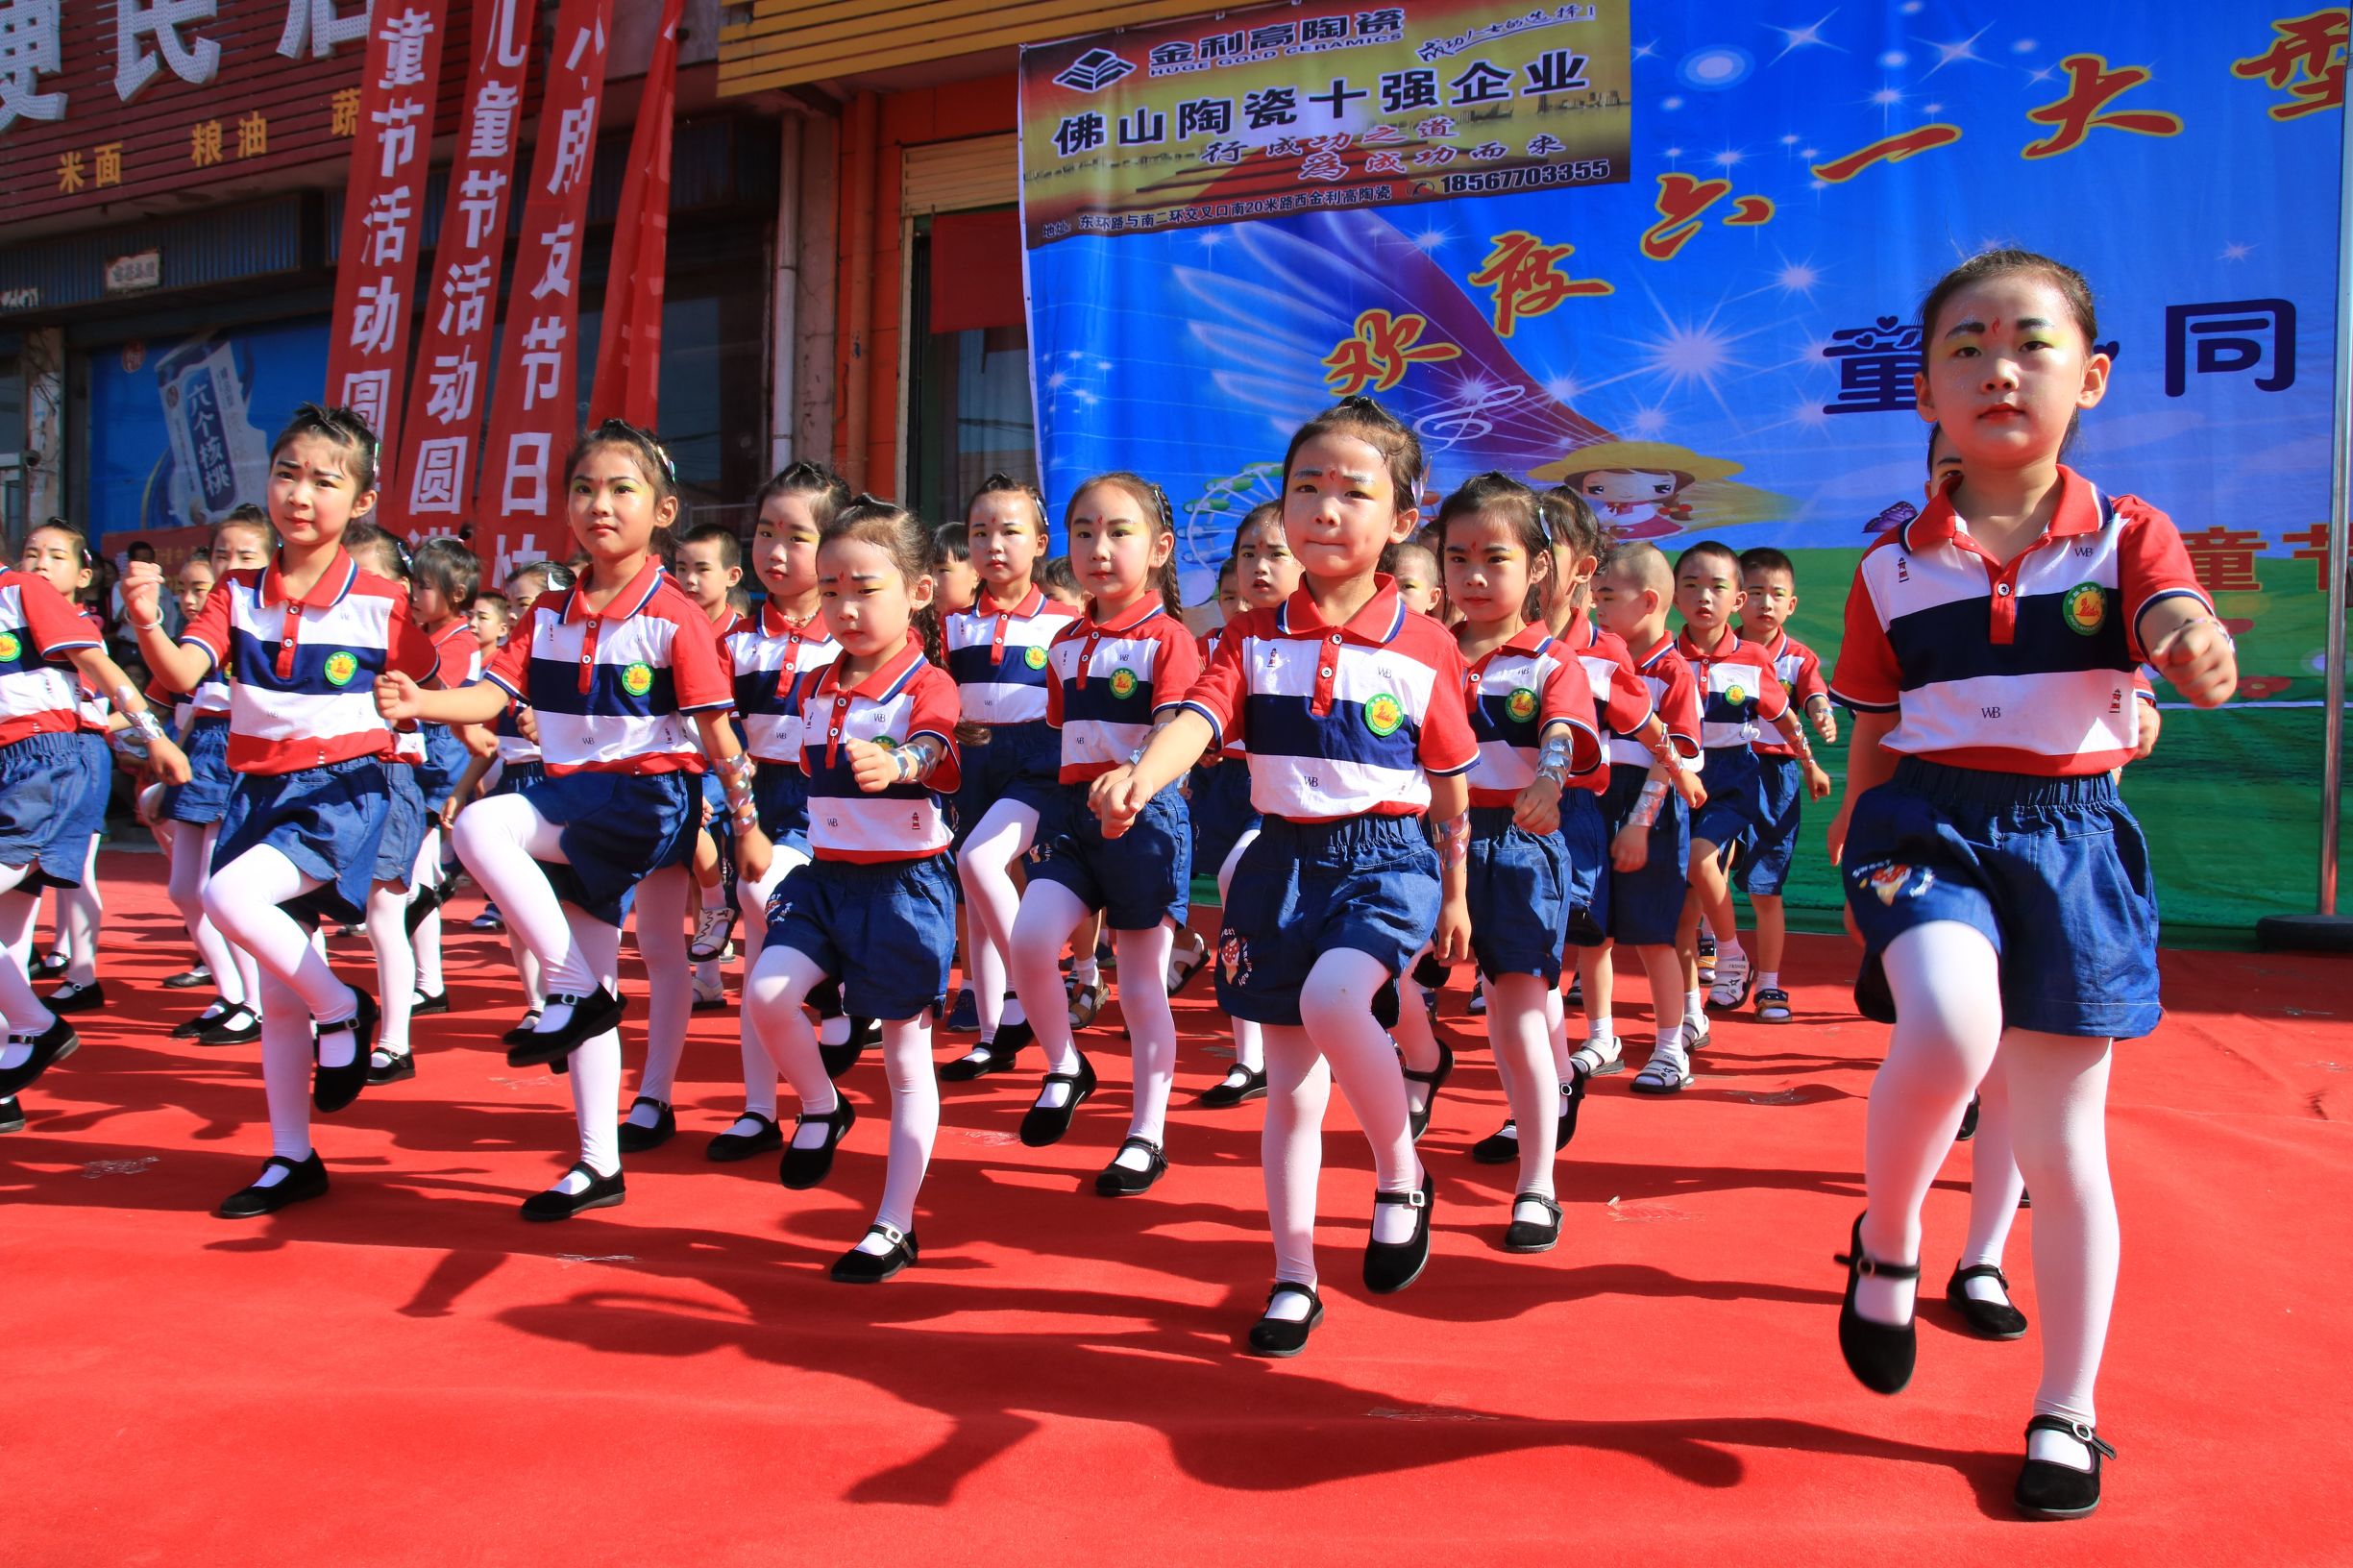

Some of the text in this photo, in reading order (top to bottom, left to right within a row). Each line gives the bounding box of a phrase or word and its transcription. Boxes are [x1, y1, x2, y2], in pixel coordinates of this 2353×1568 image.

[1149, 8, 1405, 69] 金利高陶瓷
[1150, 32, 1404, 78] HUGE GOLD CERAMICS
[1053, 48, 1590, 158] 佛山陶瓷十强企业
[190, 110, 268, 167] 粮油
[57, 142, 124, 194] 米面
[1441, 159, 1611, 195] 18567703355
[340, 7, 433, 524] 童节活动圆
[407, 0, 527, 546] 儿童节活动圆
[1823, 297, 2298, 415] 童同
[187, 383, 232, 498] 六个核桃
[2074, 547, 2095, 558] WB
[1981, 706, 2001, 719] WB
[582, 737, 596, 746] WB
[1304, 775, 1319, 788] WB
